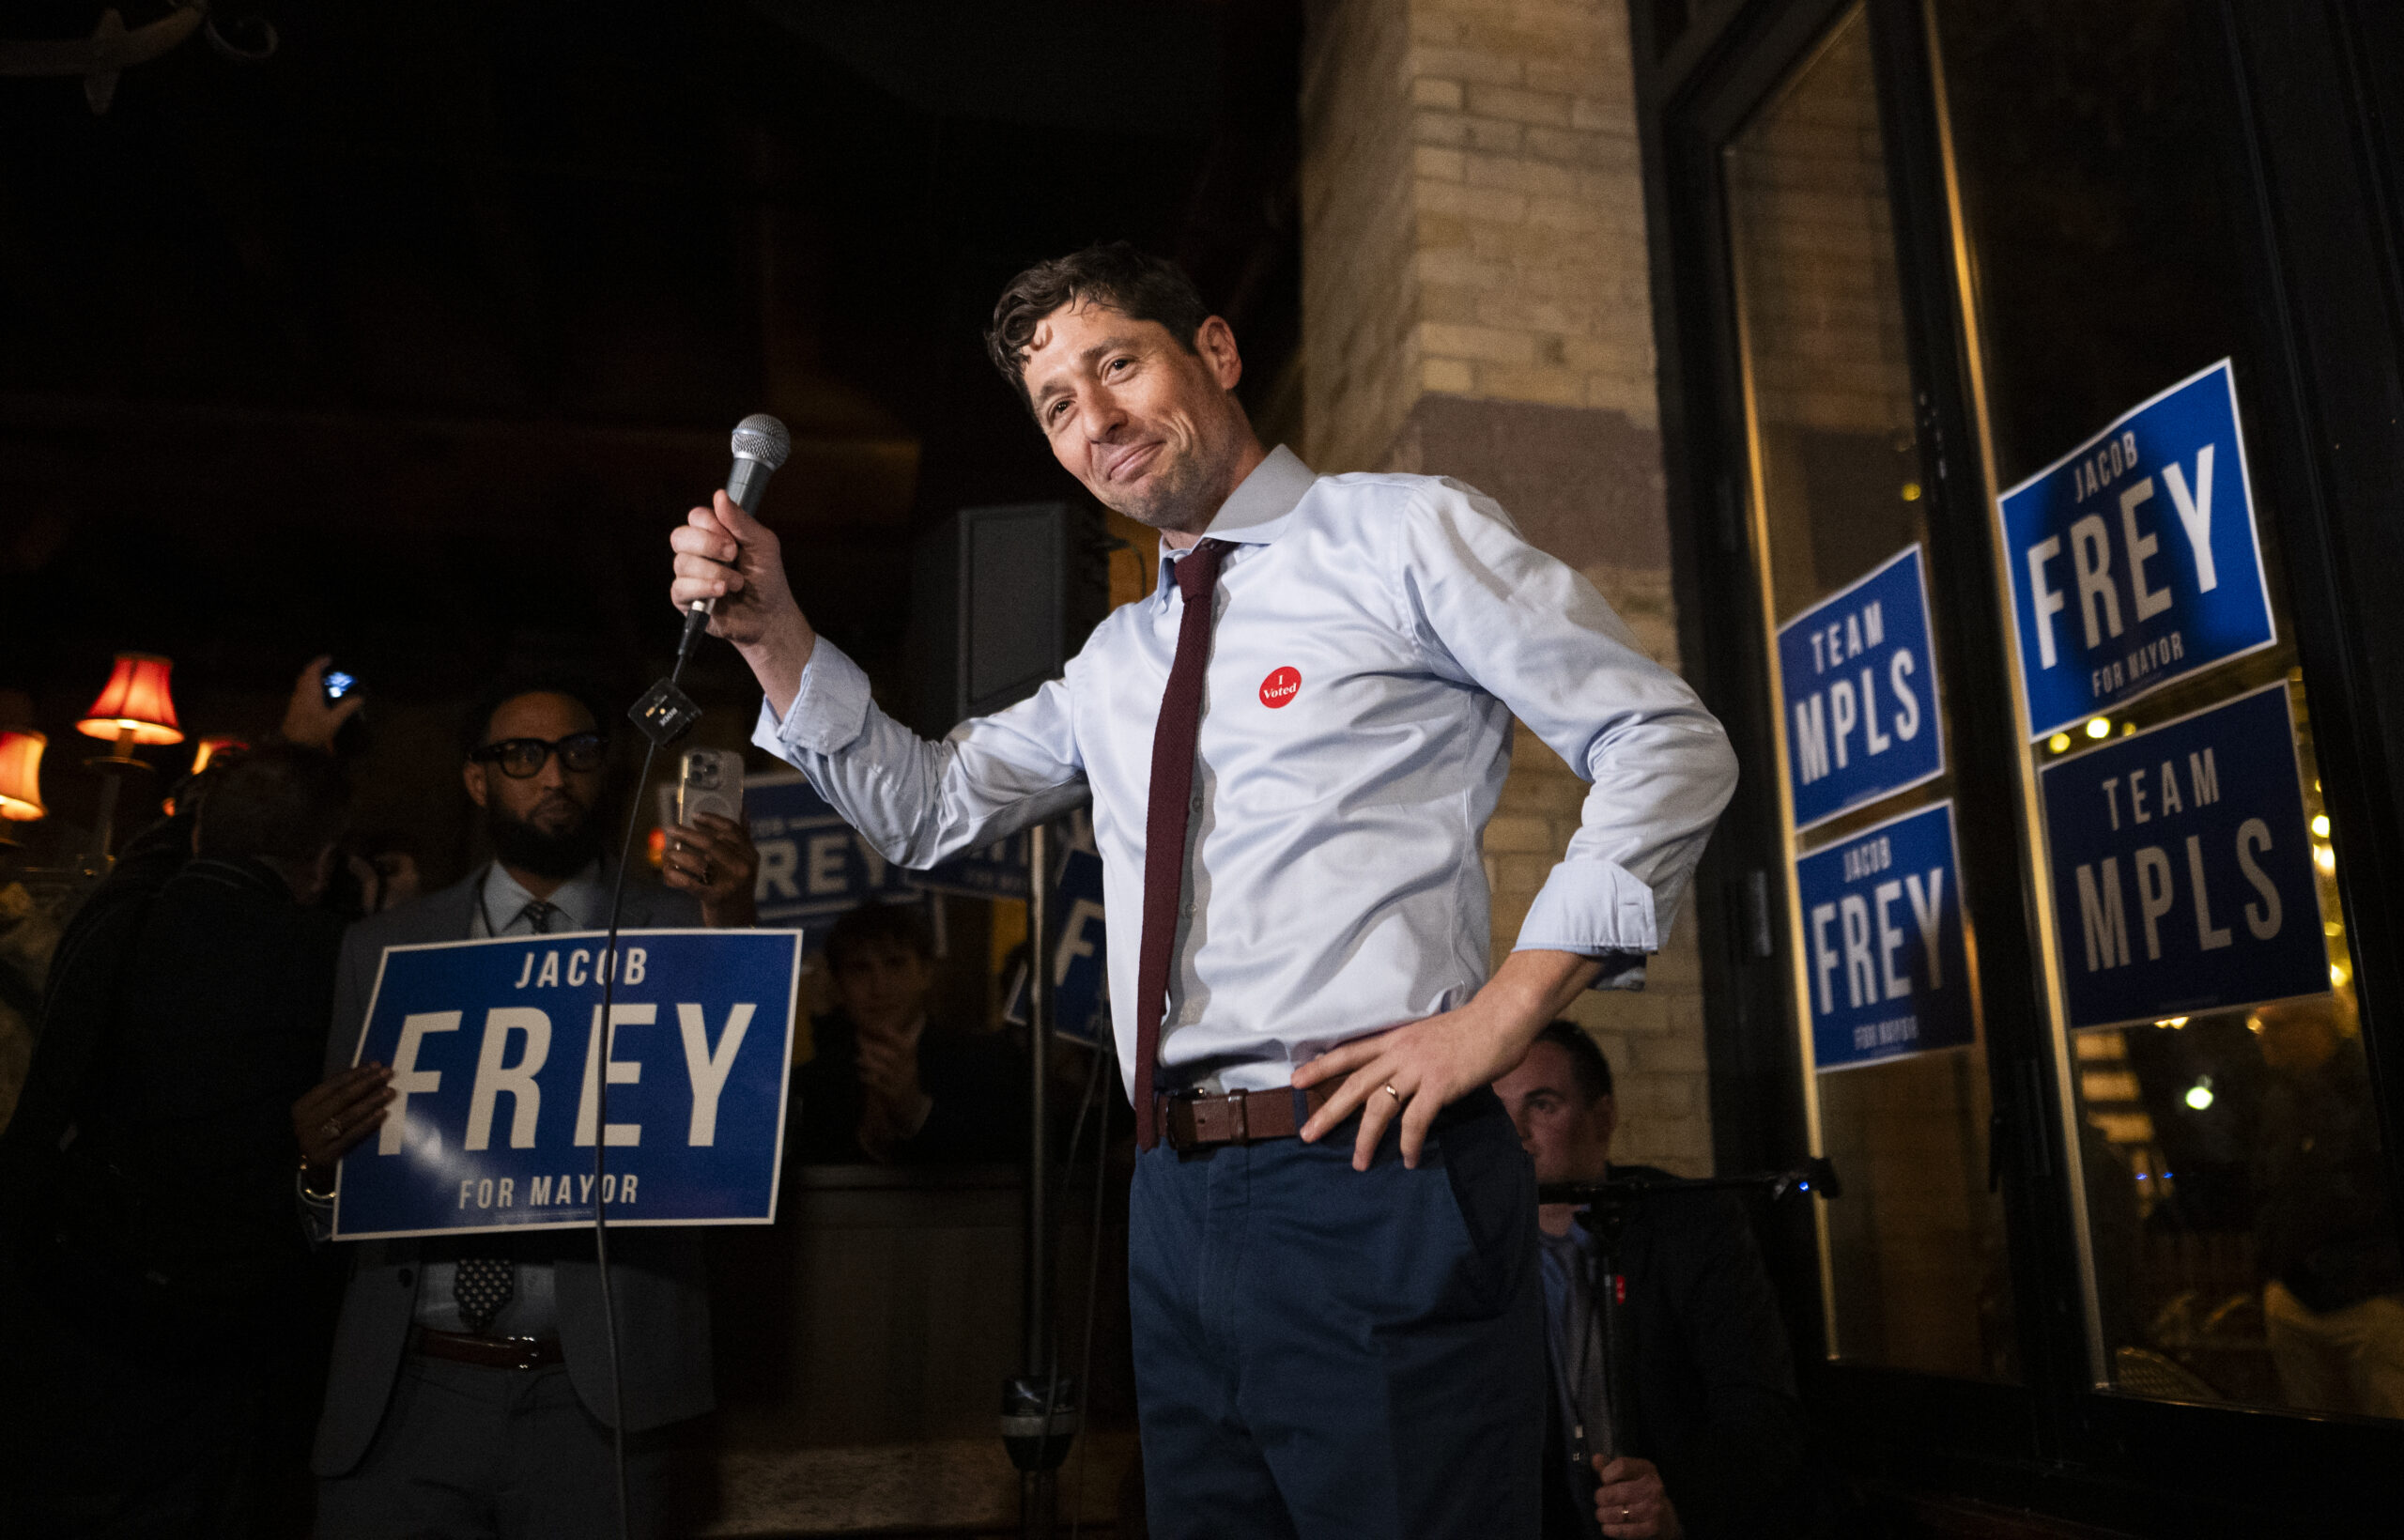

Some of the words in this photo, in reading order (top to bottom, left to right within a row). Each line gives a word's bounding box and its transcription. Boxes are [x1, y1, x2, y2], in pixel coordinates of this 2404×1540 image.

[2073, 428, 2139, 504] JACOB
[2026, 441, 2218, 671] FREY
[1810, 598, 1886, 675] TEAM
[2091, 660, 2125, 699] FOR
[2127, 630, 2185, 683] MAYOR
[1263, 682, 1298, 700] Voted
[1278, 674, 1285, 685] I
[1795, 647, 1921, 786] MPLS
[2102, 747, 2221, 832] TEAM
[754, 830, 887, 903] REY
[2075, 816, 2284, 974] MPLS
[514, 947, 648, 990] JACOB
[1811, 865, 1945, 1016] FREY
[377, 1002, 758, 1157] FREY
[458, 1177, 515, 1210] FOR
[529, 1174, 640, 1207] MAYOR
